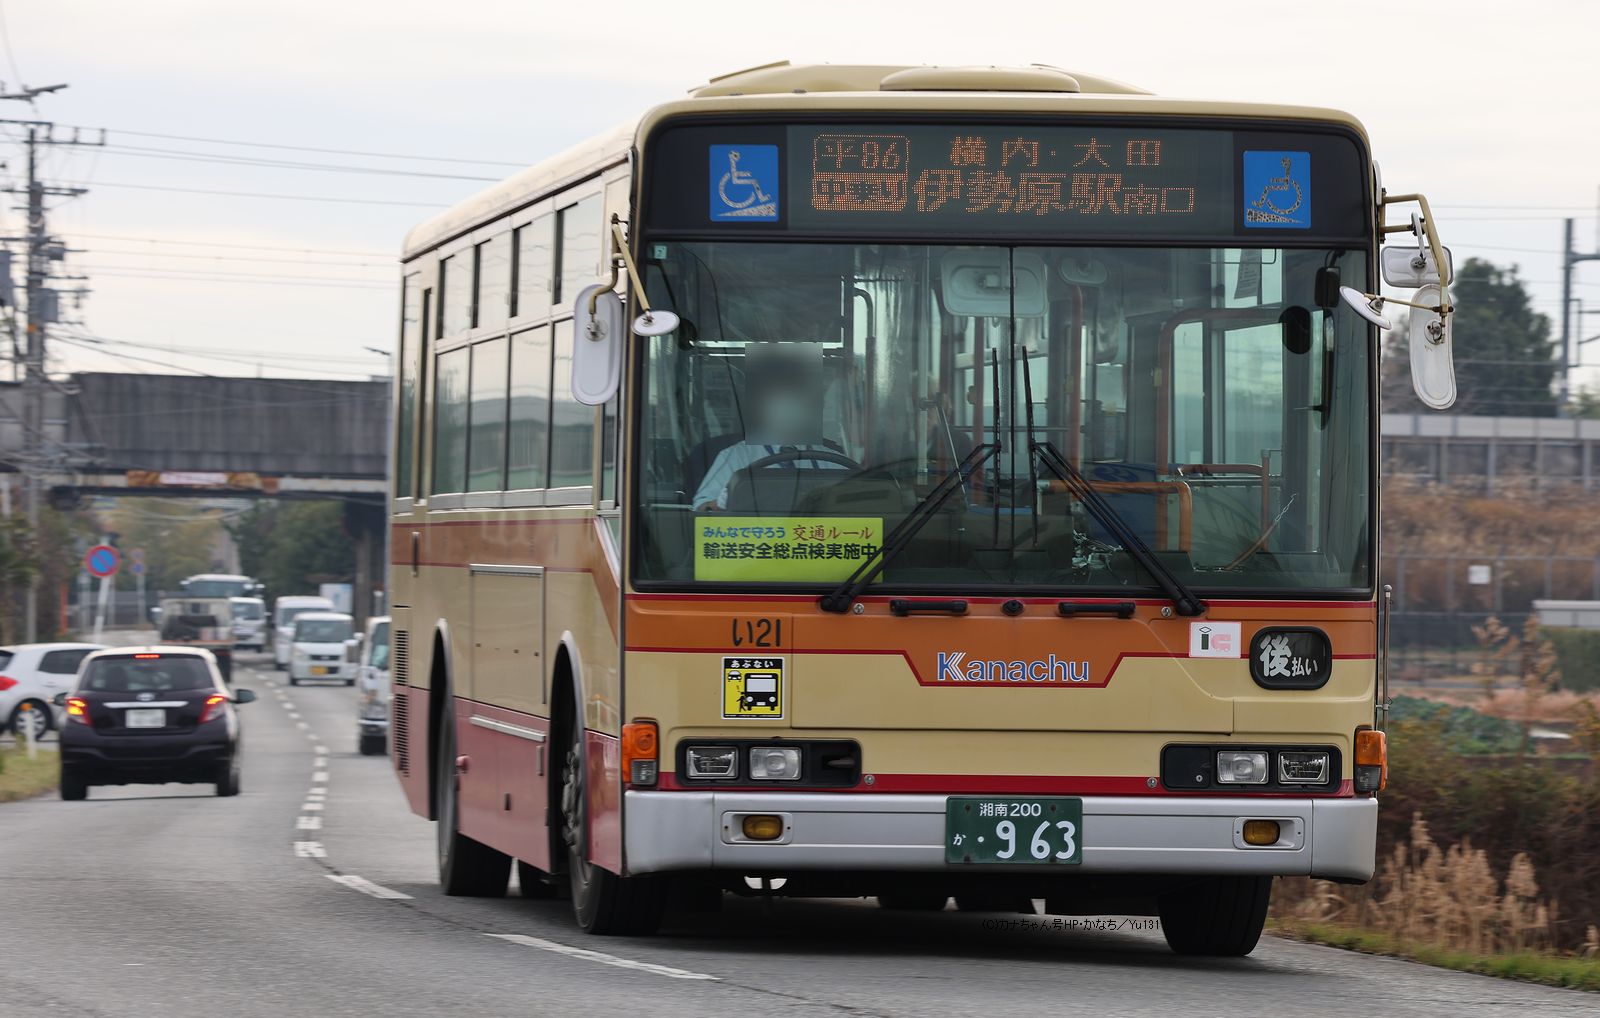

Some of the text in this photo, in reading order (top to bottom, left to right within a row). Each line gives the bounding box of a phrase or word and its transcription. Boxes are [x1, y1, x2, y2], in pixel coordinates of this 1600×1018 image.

[912, 168, 1195, 216] 伊勢原駅南口
[703, 524, 874, 542] みんなで守ろう 交通ルール
[703, 542, 878, 560] 輸送安全総点検実施中
[733, 618, 781, 647] い21
[731, 660, 774, 669] あぶない
[937, 652, 1089, 682] Kanachu
[1259, 634, 1318, 677] 後払い
